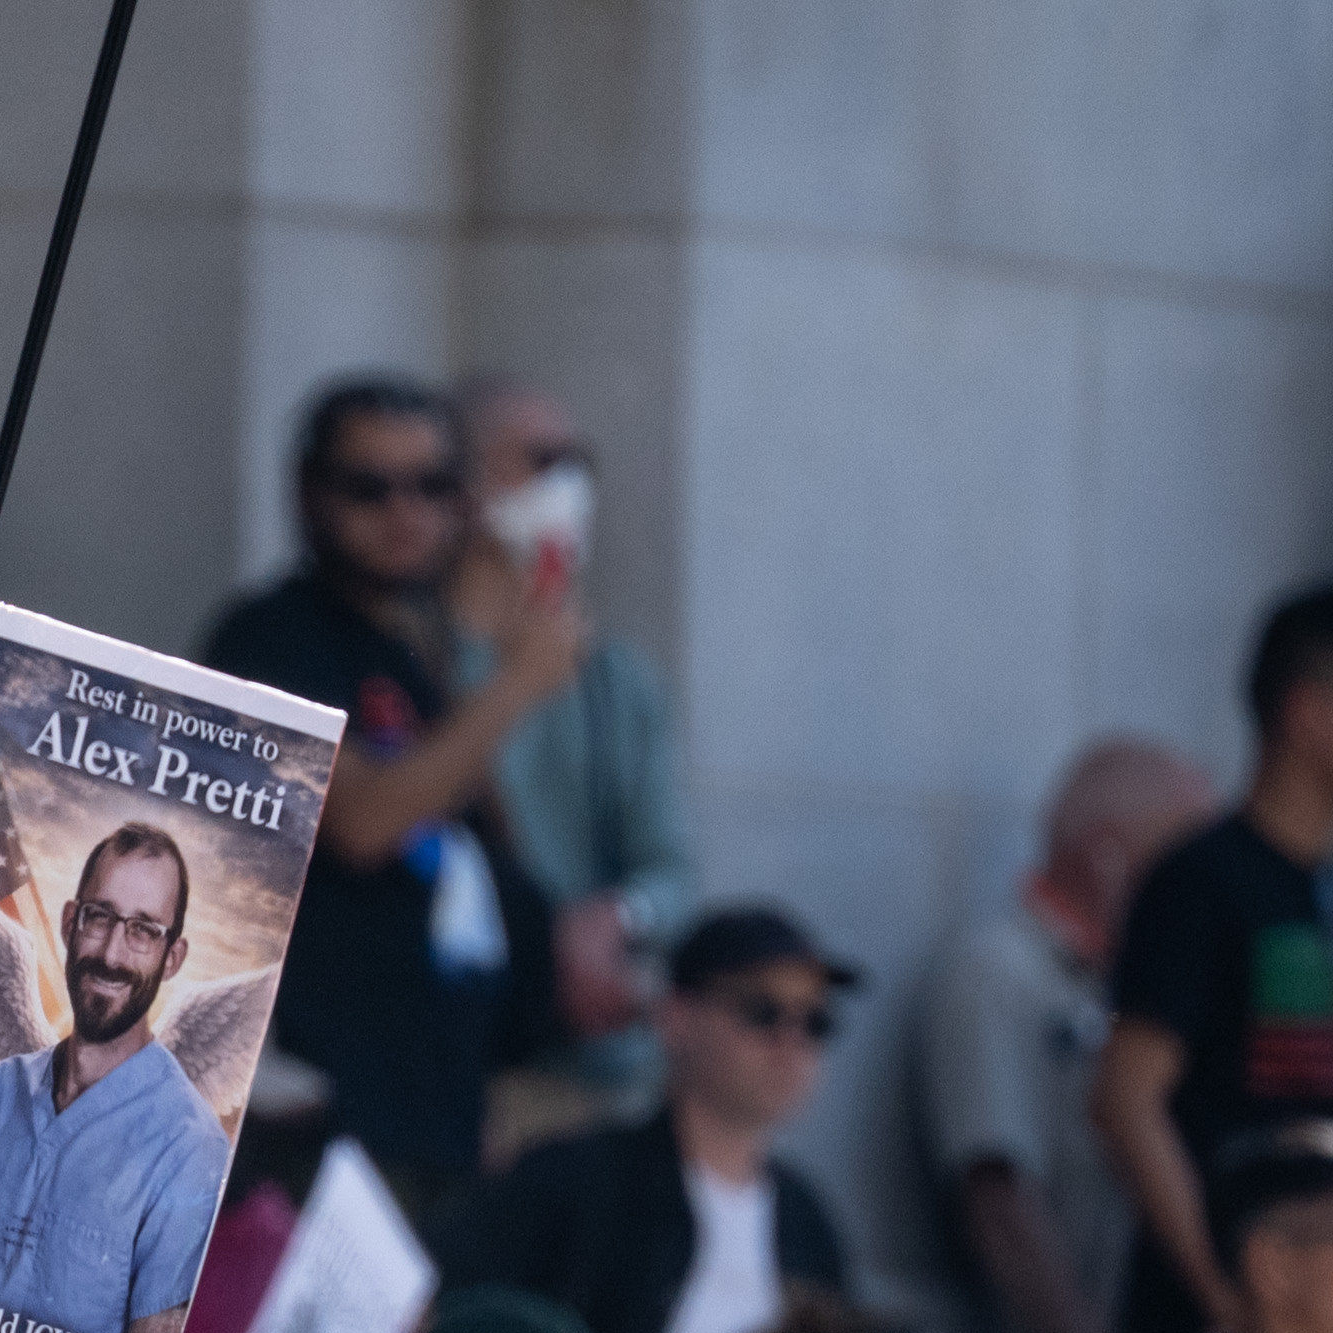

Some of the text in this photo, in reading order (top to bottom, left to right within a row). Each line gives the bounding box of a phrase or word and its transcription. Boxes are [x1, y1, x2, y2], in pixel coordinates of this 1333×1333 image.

[66, 669, 279, 762] Rest in power to
[27, 712, 286, 831] Alex Pretti
